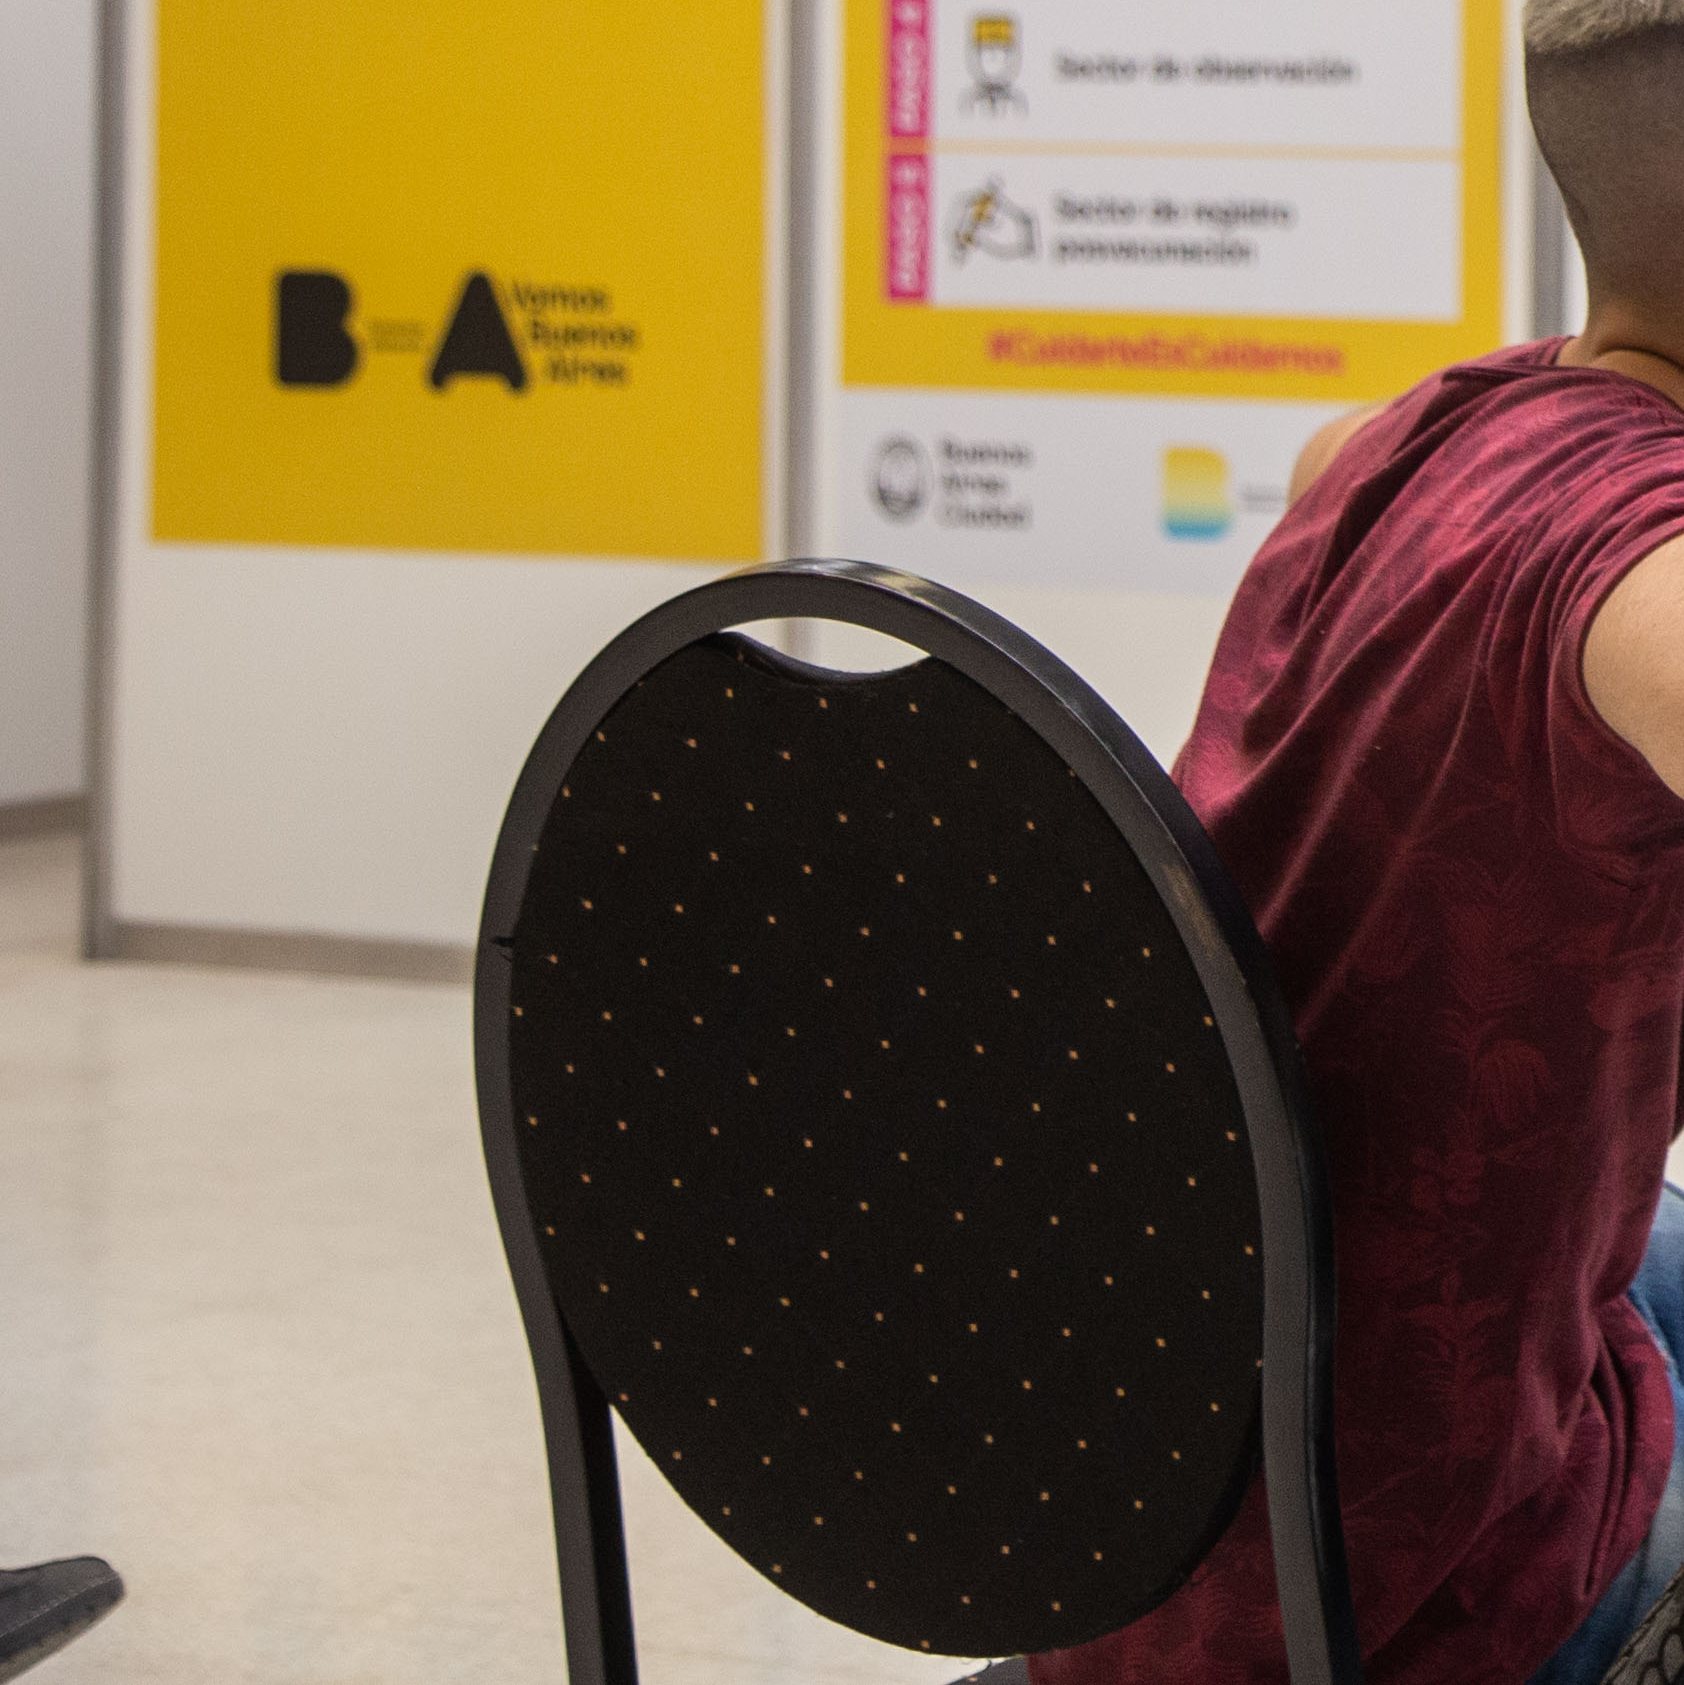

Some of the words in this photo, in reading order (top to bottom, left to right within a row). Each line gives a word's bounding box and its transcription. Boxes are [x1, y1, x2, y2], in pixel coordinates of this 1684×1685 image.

[1054, 49, 1143, 82] Sector
[1146, 51, 1185, 82] de
[1053, 190, 1143, 223] Sector
[1144, 194, 1184, 224] de
[509, 282, 609, 312] Vamos
[527, 317, 638, 349] Buenos
